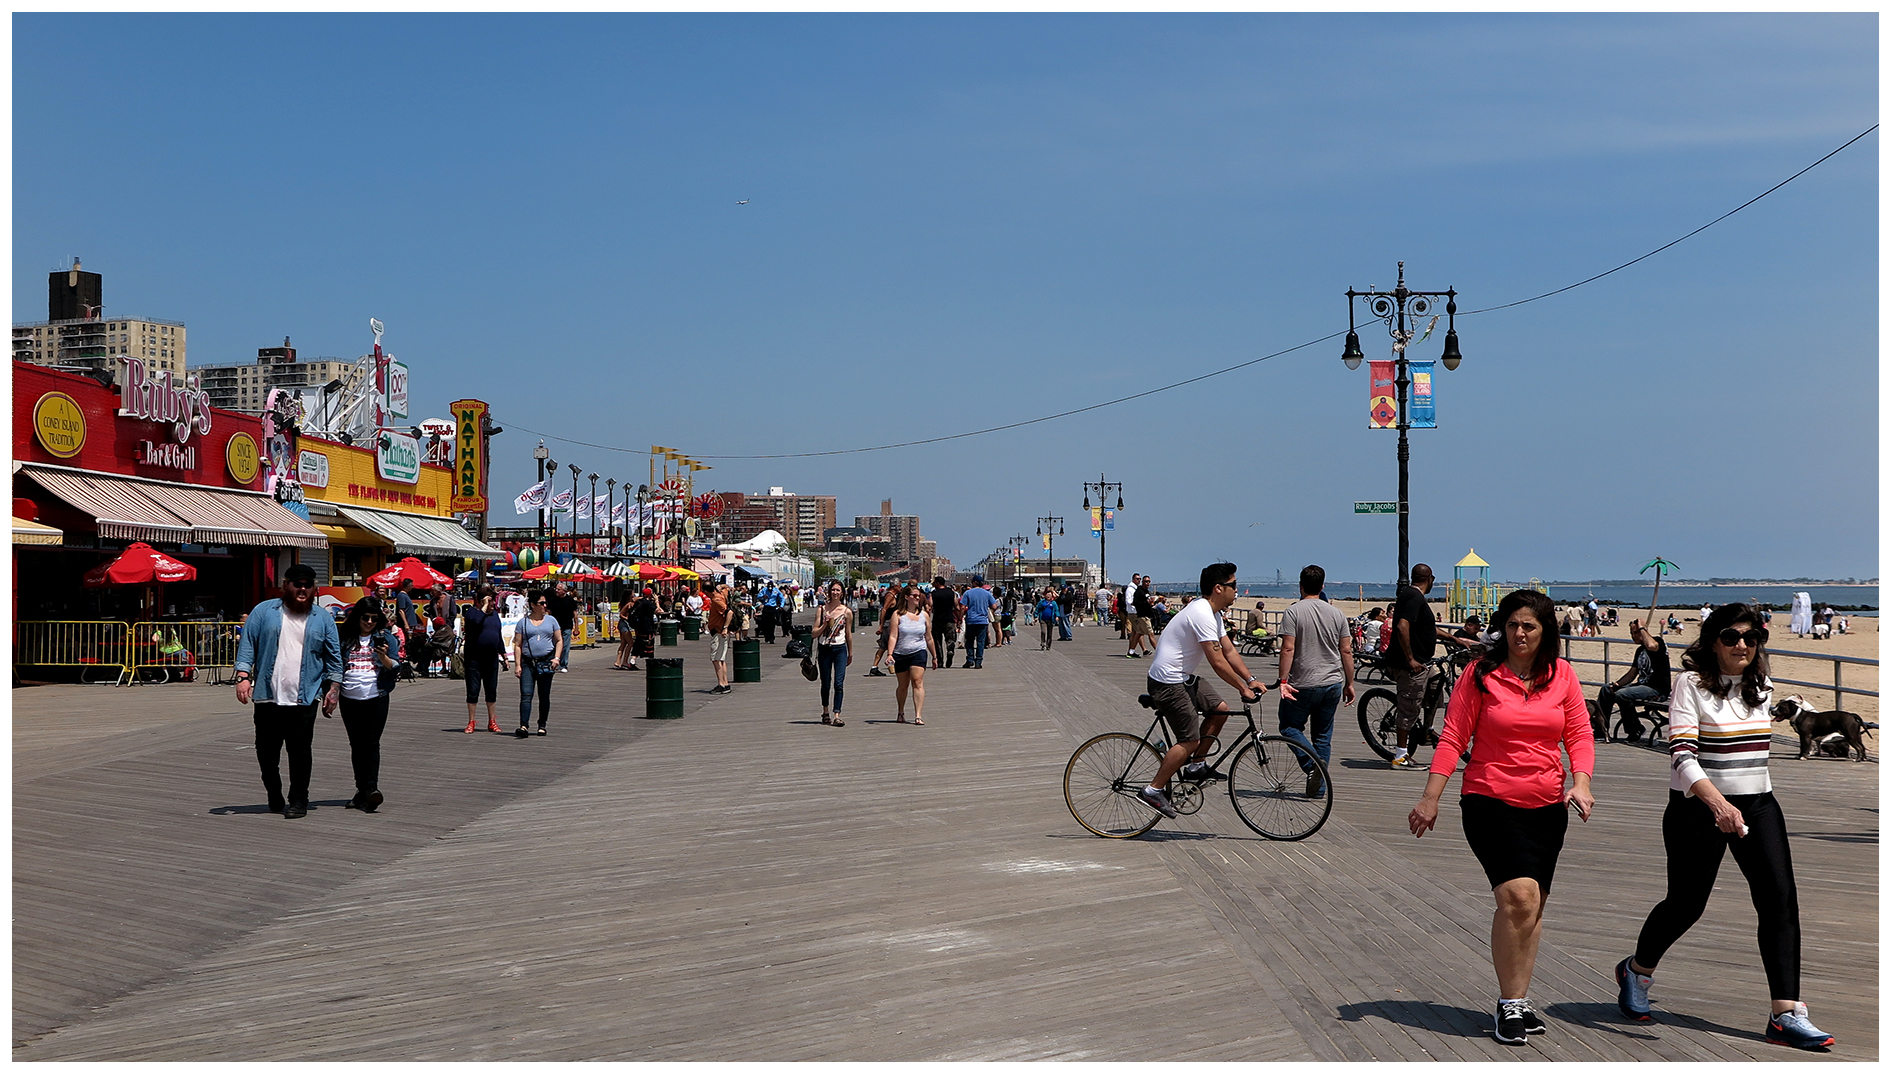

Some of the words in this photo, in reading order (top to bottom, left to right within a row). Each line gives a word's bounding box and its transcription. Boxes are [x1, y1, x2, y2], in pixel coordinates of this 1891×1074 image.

[117, 354, 212, 443] Ruby's
[59, 404, 64, 414] A
[43, 416, 55, 430] CONEY
[57, 419, 79, 432] ISLAND
[48, 432, 75, 446] TRADITION
[237, 442, 251, 458] SINCE
[461, 410, 475, 497] NATHANS
[1355, 503, 1373, 512] Ruby
[1373, 502, 1396, 510] Jacobs
